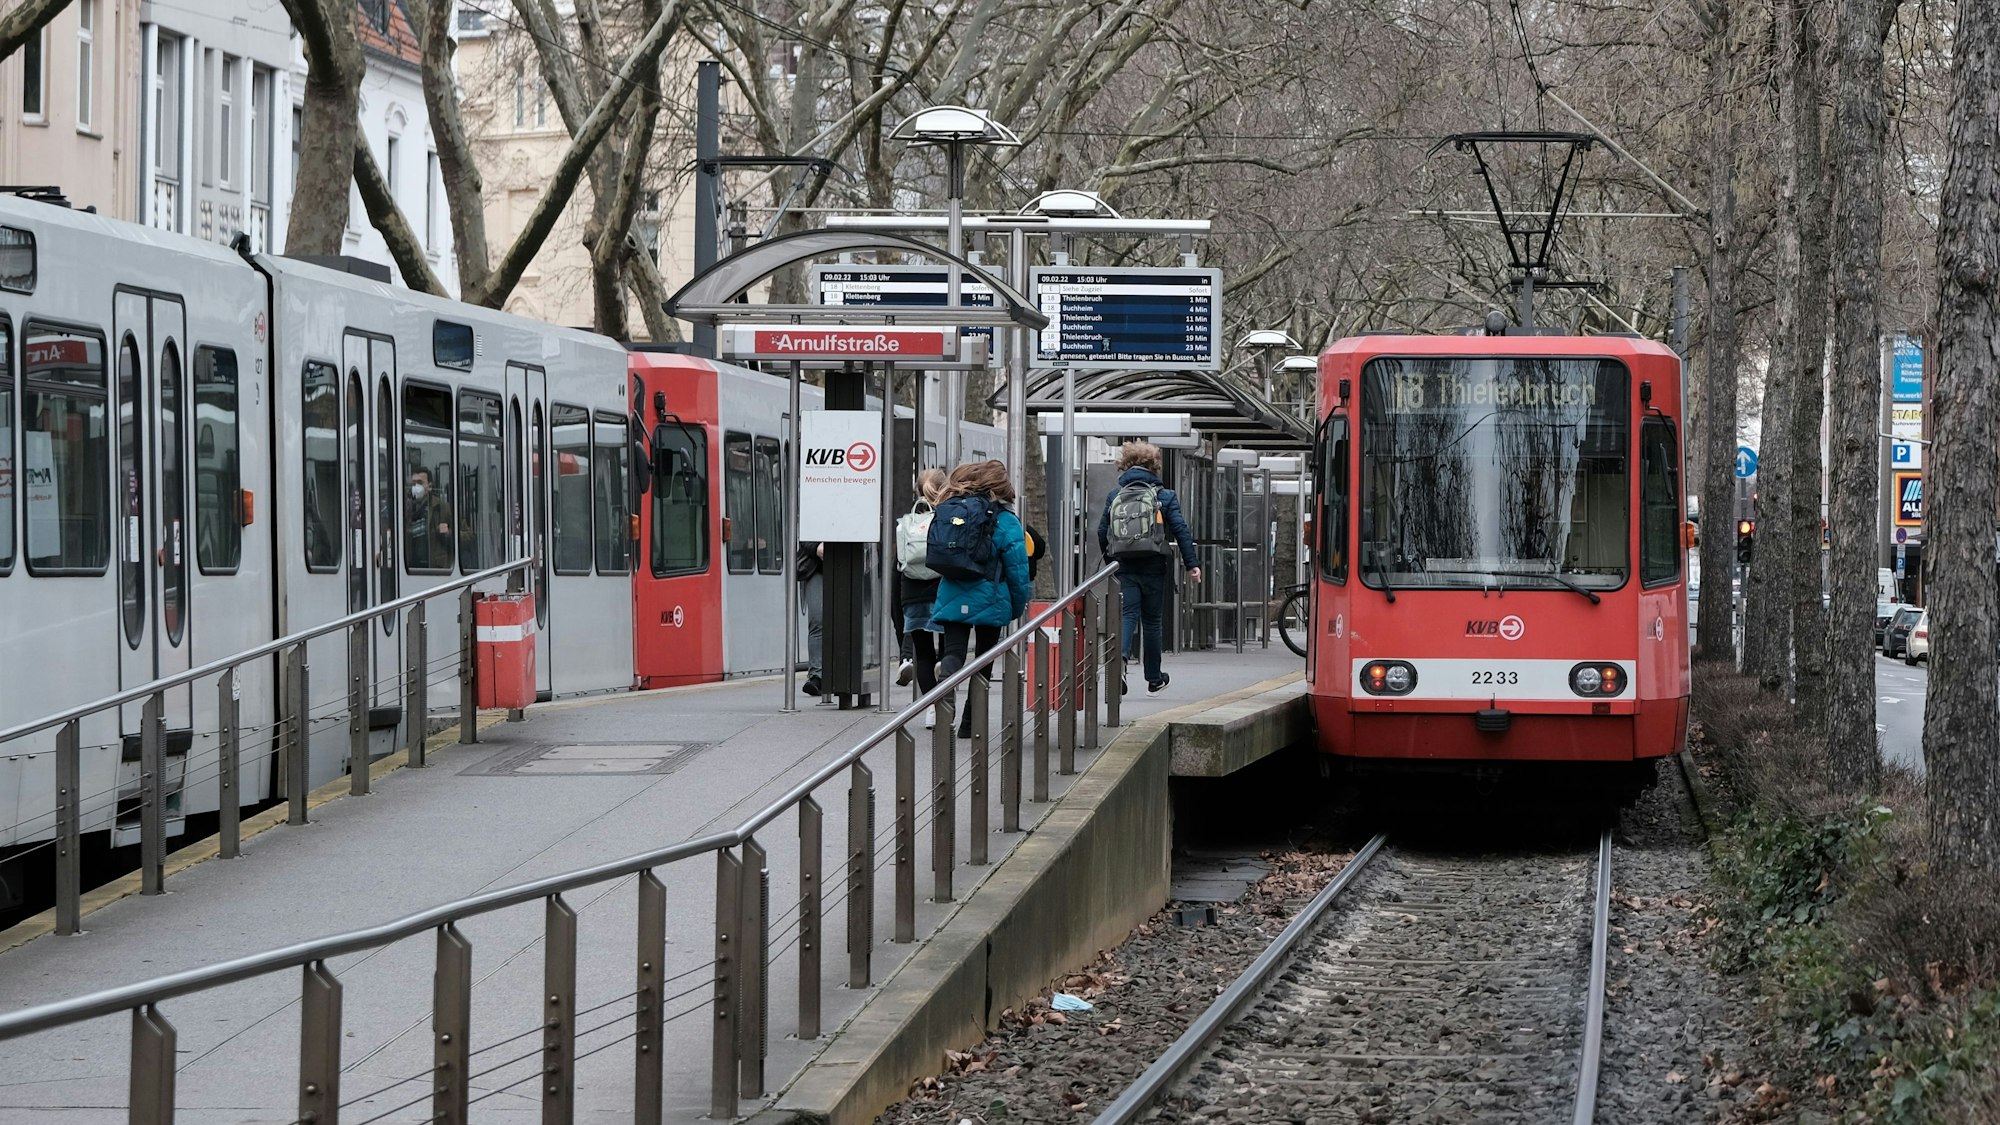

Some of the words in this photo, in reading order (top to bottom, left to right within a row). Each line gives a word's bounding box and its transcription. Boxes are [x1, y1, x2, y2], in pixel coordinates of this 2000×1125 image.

[845, 293, 881, 301] Klettenberg
[778, 334, 900, 352] Arnulfstraße
[1133, 353, 1153, 361] tragen
[1172, 354, 1196, 362] Bussen,
[1394, 373, 1424, 408] 18
[1437, 373, 1596, 406] Thielenbruch
[805, 448, 845, 465] KVB
[805, 476, 841, 484] Menschen
[843, 476, 876, 485] bewegen
[1465, 621, 1499, 634] KVB
[1471, 671, 1518, 684] 2233
